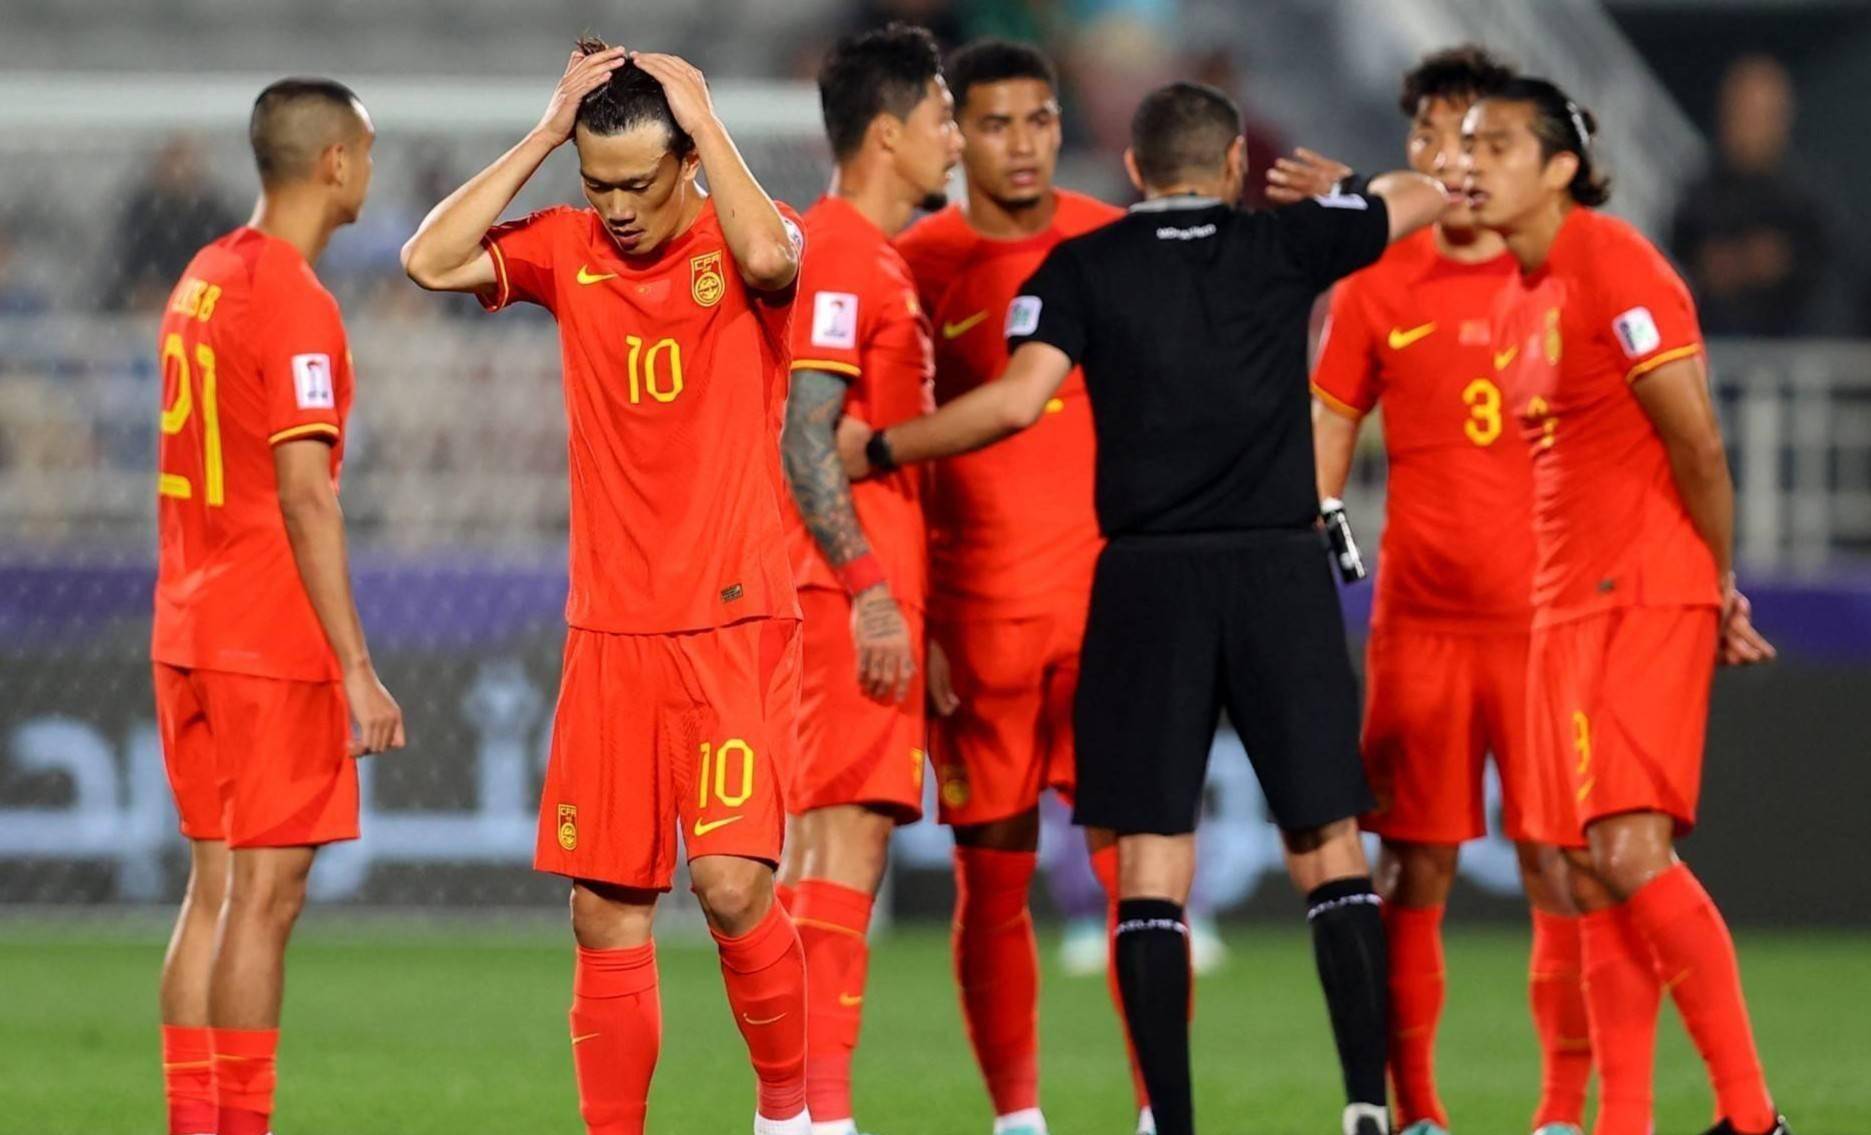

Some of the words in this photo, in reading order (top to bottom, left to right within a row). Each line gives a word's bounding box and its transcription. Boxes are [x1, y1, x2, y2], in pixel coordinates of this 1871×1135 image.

[626, 335, 683, 403] 10
[1462, 378, 1501, 446] 3
[700, 738, 754, 808] 10
